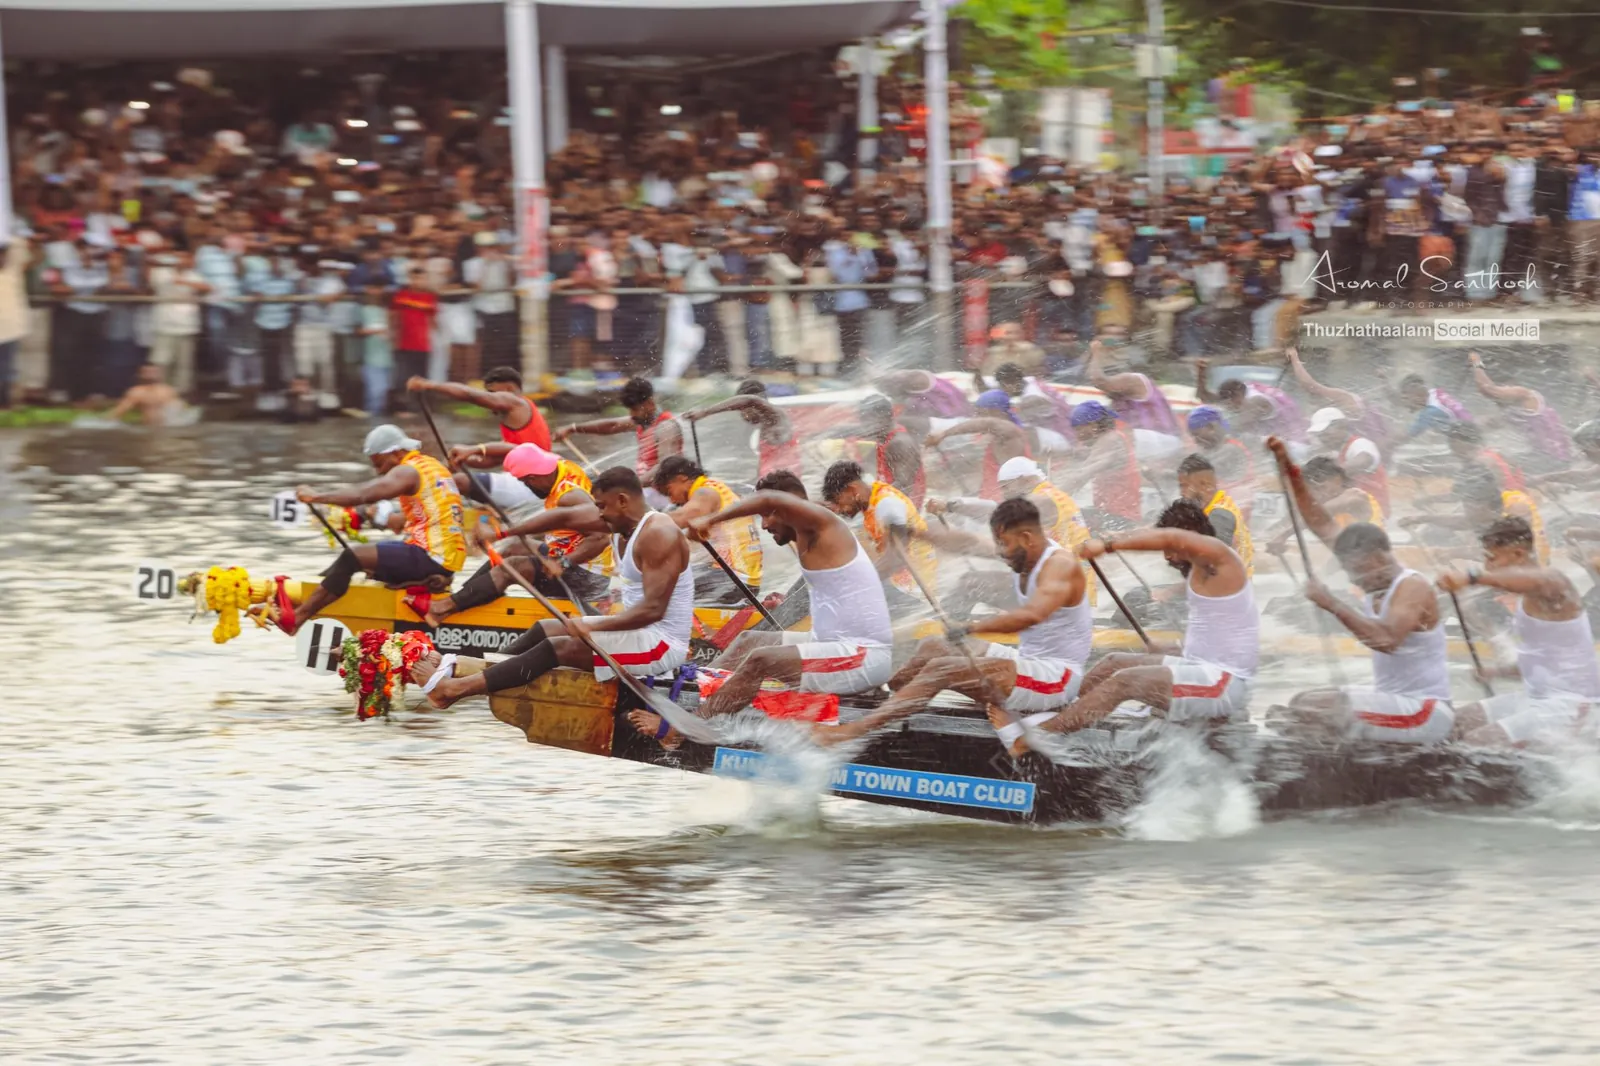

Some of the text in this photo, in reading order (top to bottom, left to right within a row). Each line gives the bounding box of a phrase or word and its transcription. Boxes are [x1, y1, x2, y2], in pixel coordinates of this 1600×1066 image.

[274, 499, 297, 522] 15
[138, 567, 174, 600] 20
[306, 623, 344, 672] 11
[853, 770, 912, 793] TOWN
[916, 779, 970, 800] BOAT
[973, 784, 1027, 806] CLUB
